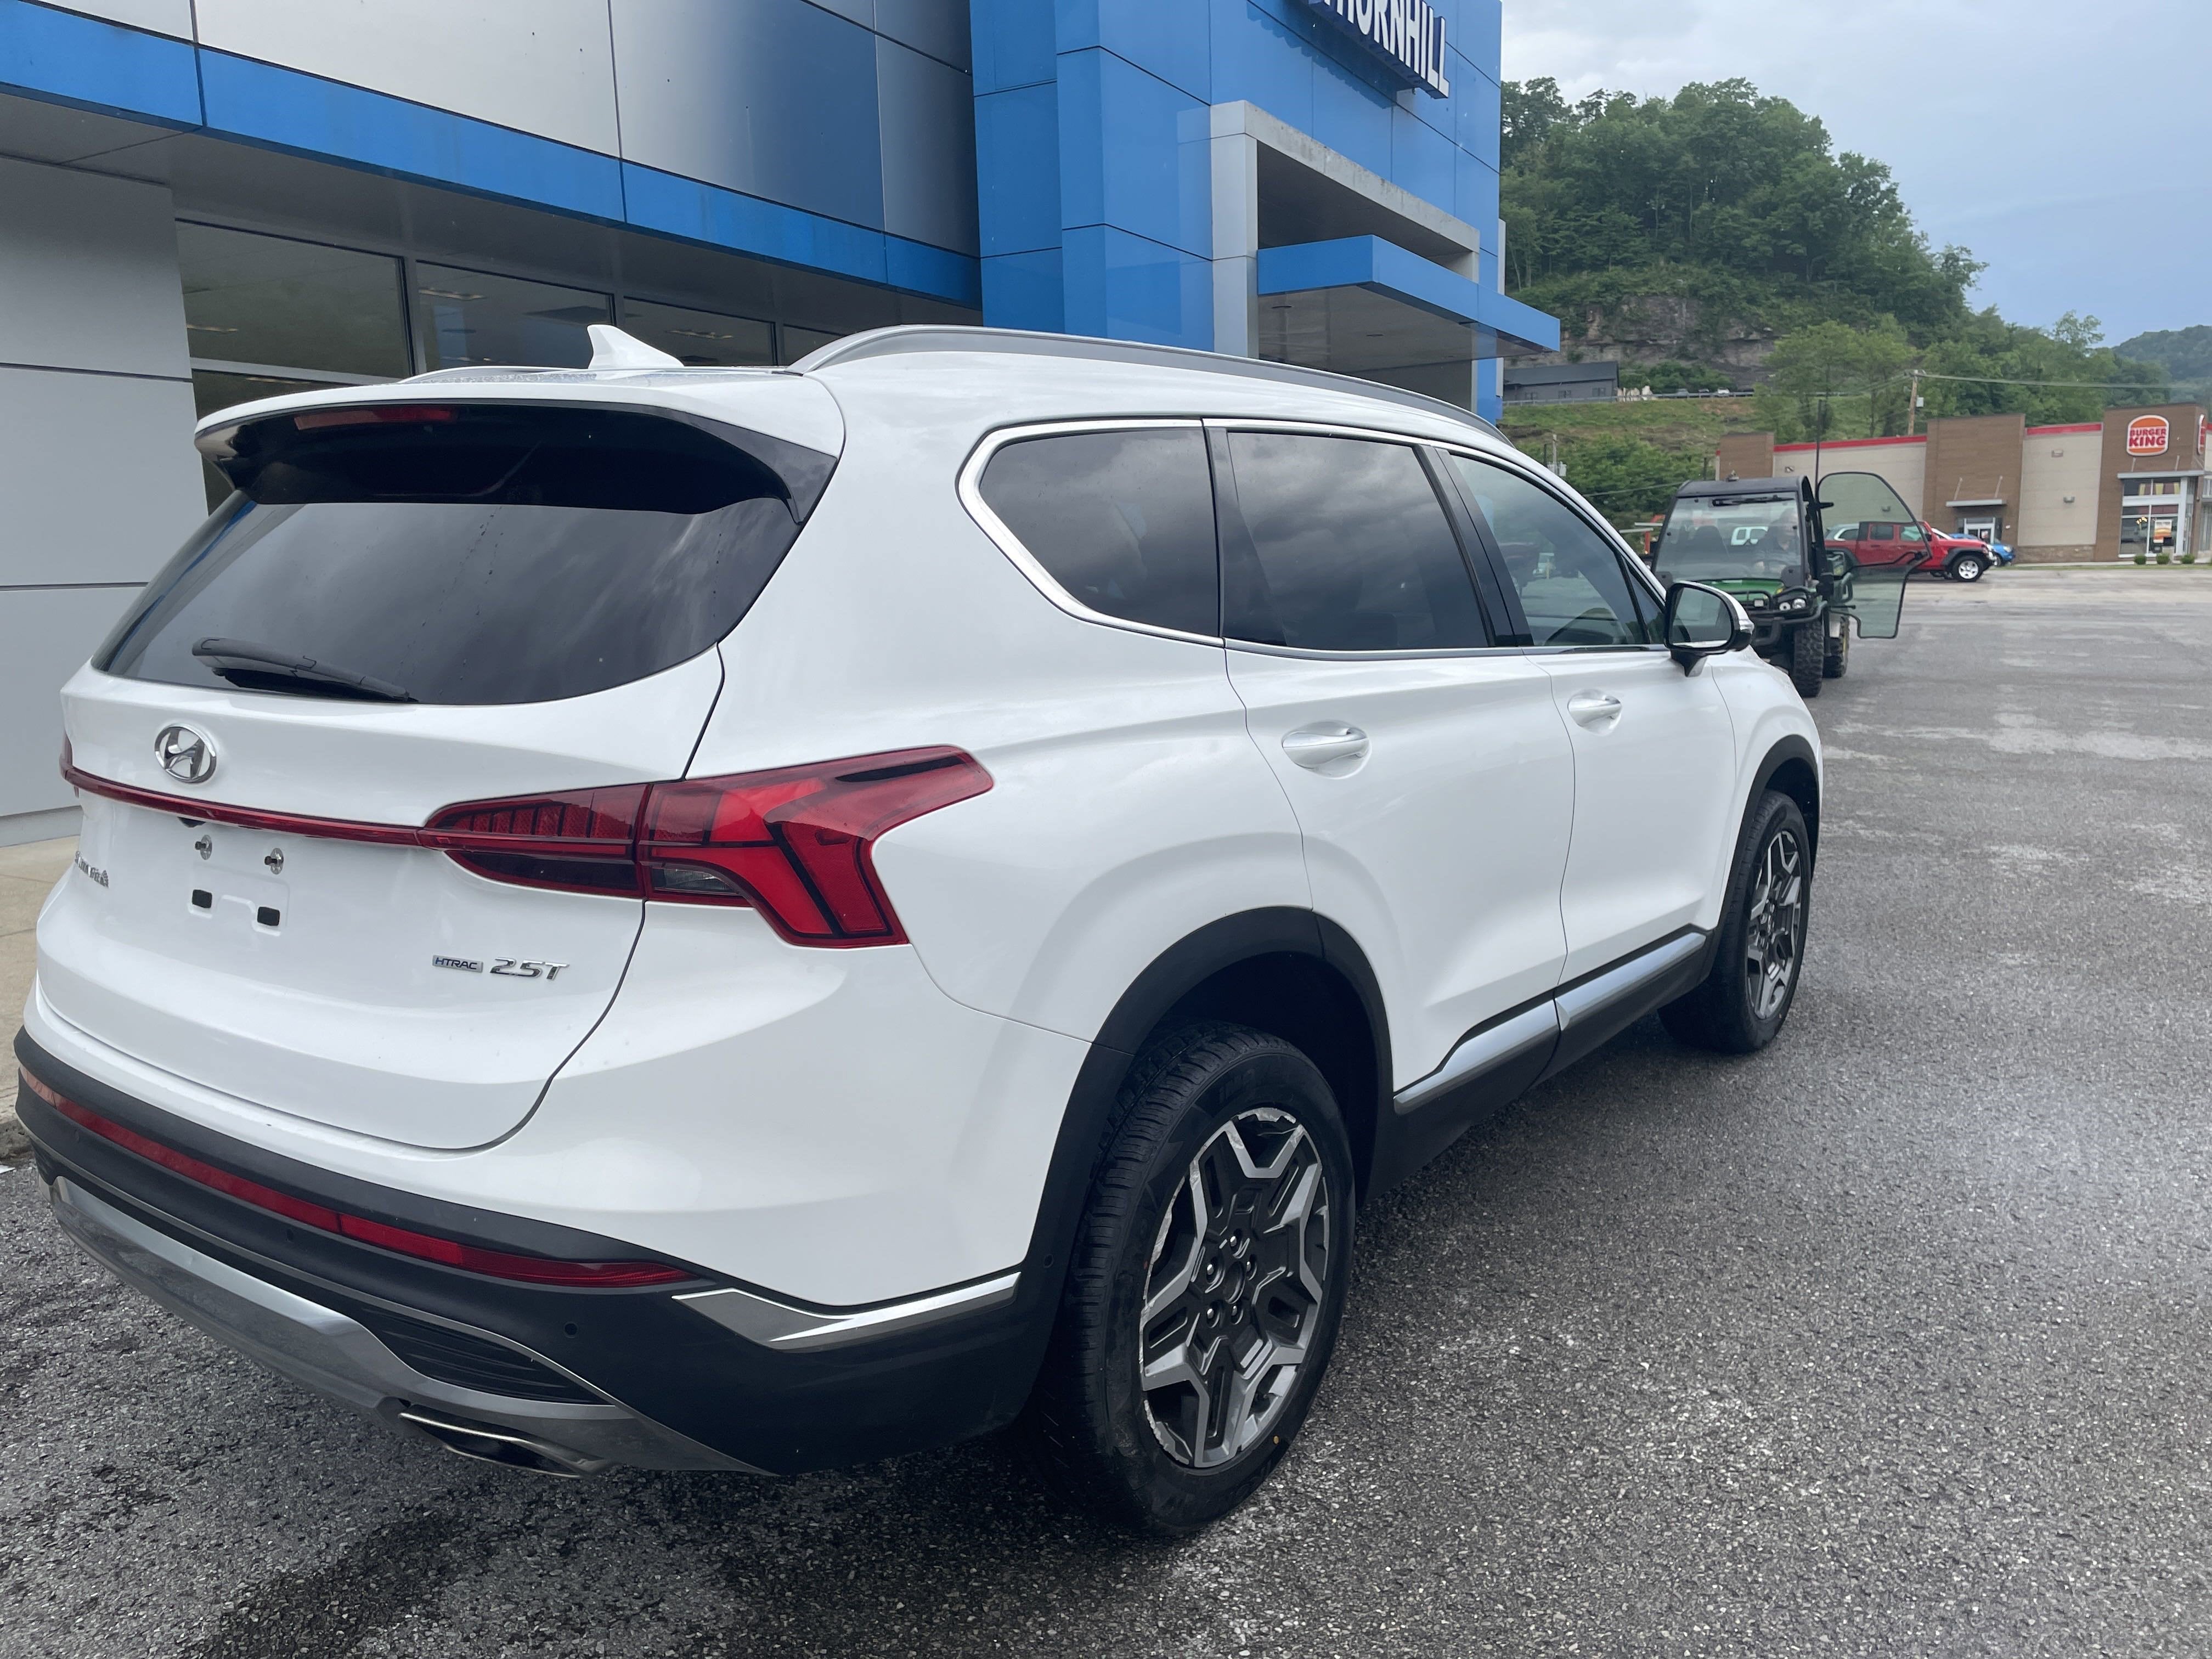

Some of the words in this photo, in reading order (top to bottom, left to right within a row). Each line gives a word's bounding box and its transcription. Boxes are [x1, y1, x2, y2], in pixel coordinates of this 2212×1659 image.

[1323, 0, 1449, 98] RNHILL
[2129, 436, 2165, 447] KING
[435, 957, 478, 970] HTRAC
